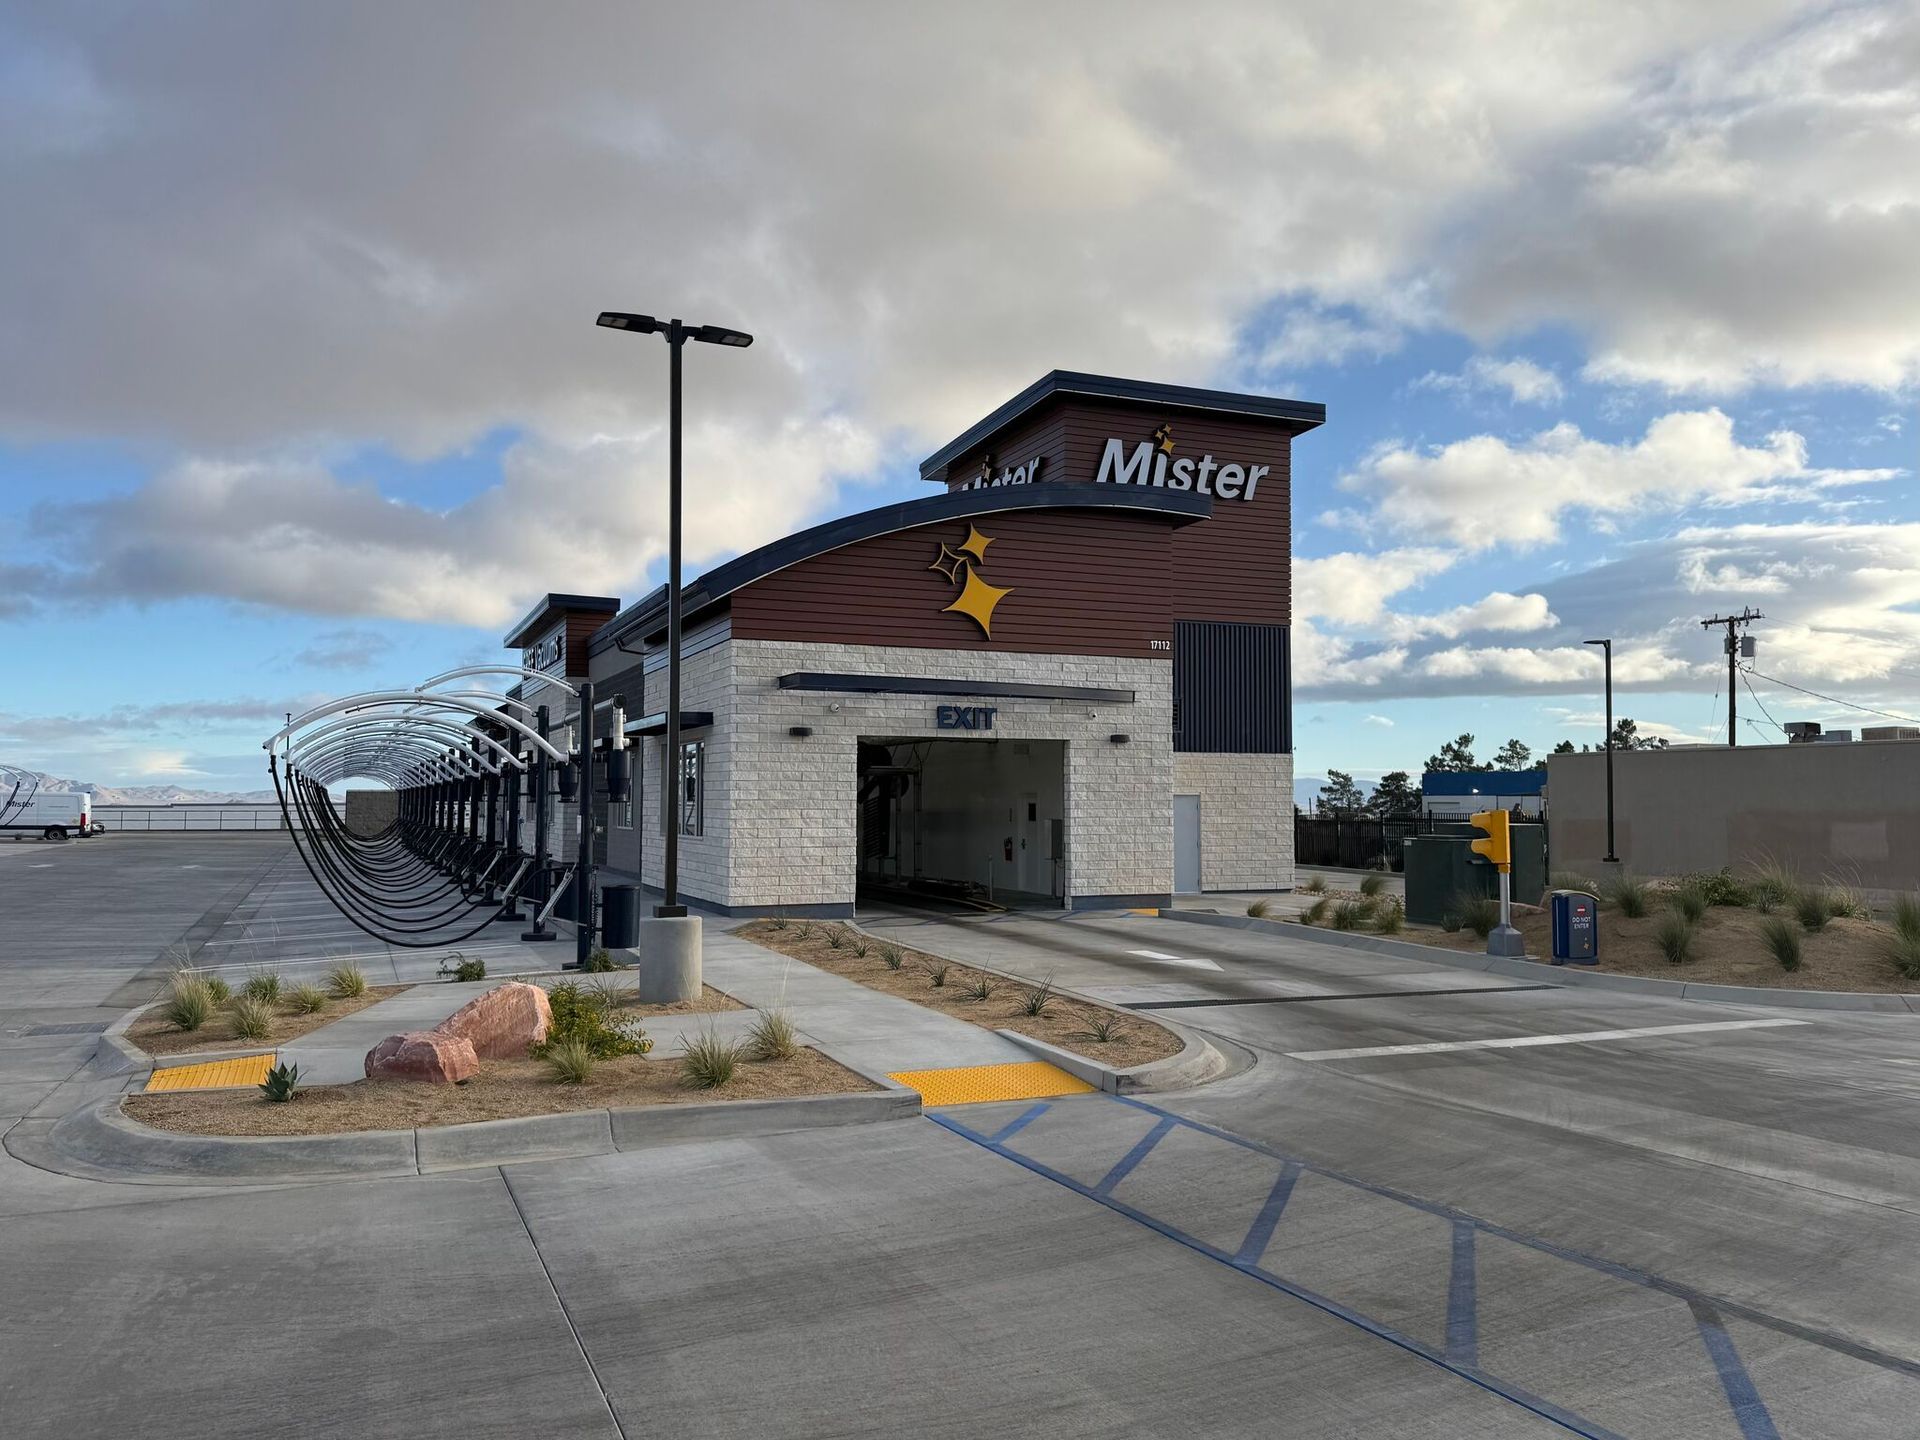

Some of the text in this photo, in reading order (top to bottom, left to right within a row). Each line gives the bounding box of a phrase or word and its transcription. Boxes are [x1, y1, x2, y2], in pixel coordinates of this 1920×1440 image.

[961, 456, 1040, 491] ter
[1096, 437, 1270, 501] Mister
[1150, 640, 1170, 650] 17112
[937, 706, 997, 730] EXIT
